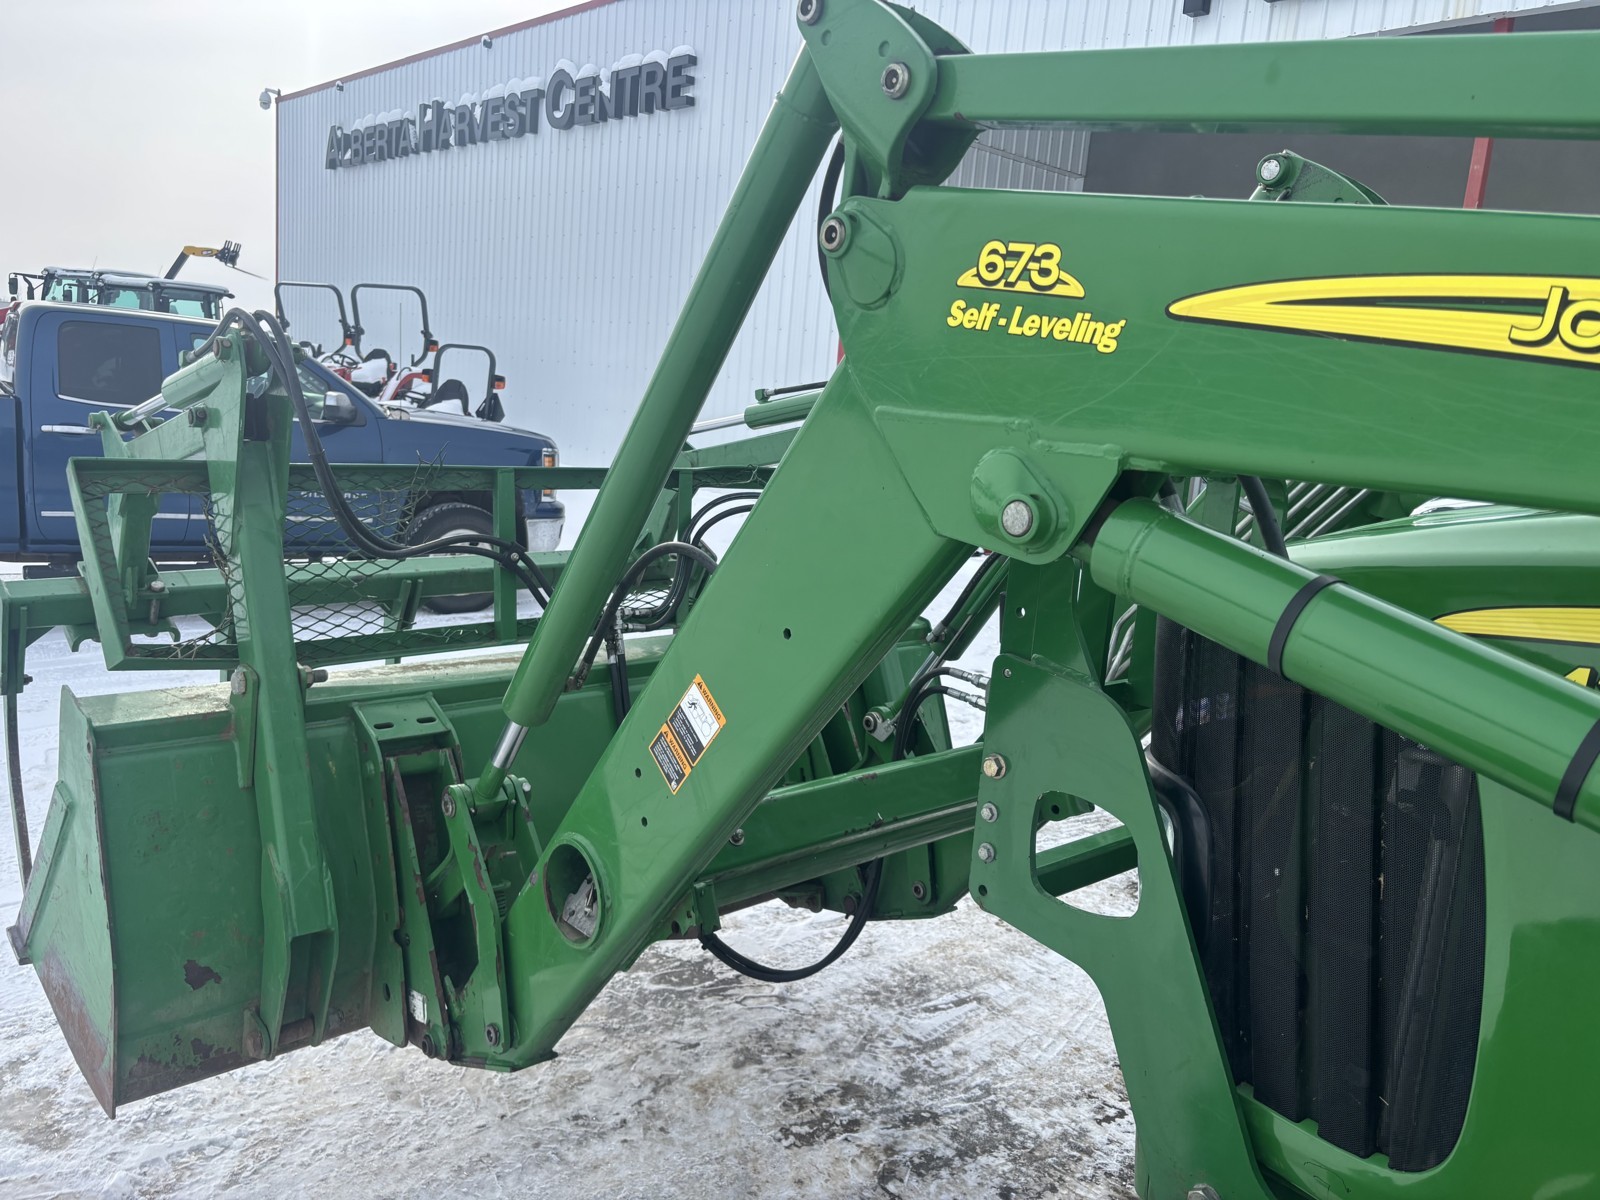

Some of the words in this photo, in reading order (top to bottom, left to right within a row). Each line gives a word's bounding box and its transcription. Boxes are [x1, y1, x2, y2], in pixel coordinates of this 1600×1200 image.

[325, 118, 420, 169] ALBERTA
[419, 88, 546, 152] HARVEST
[545, 53, 698, 131] CENTRE
[977, 239, 1062, 292] 673
[701, 688, 722, 721] WARNING
[668, 737, 688, 771] WARNING
